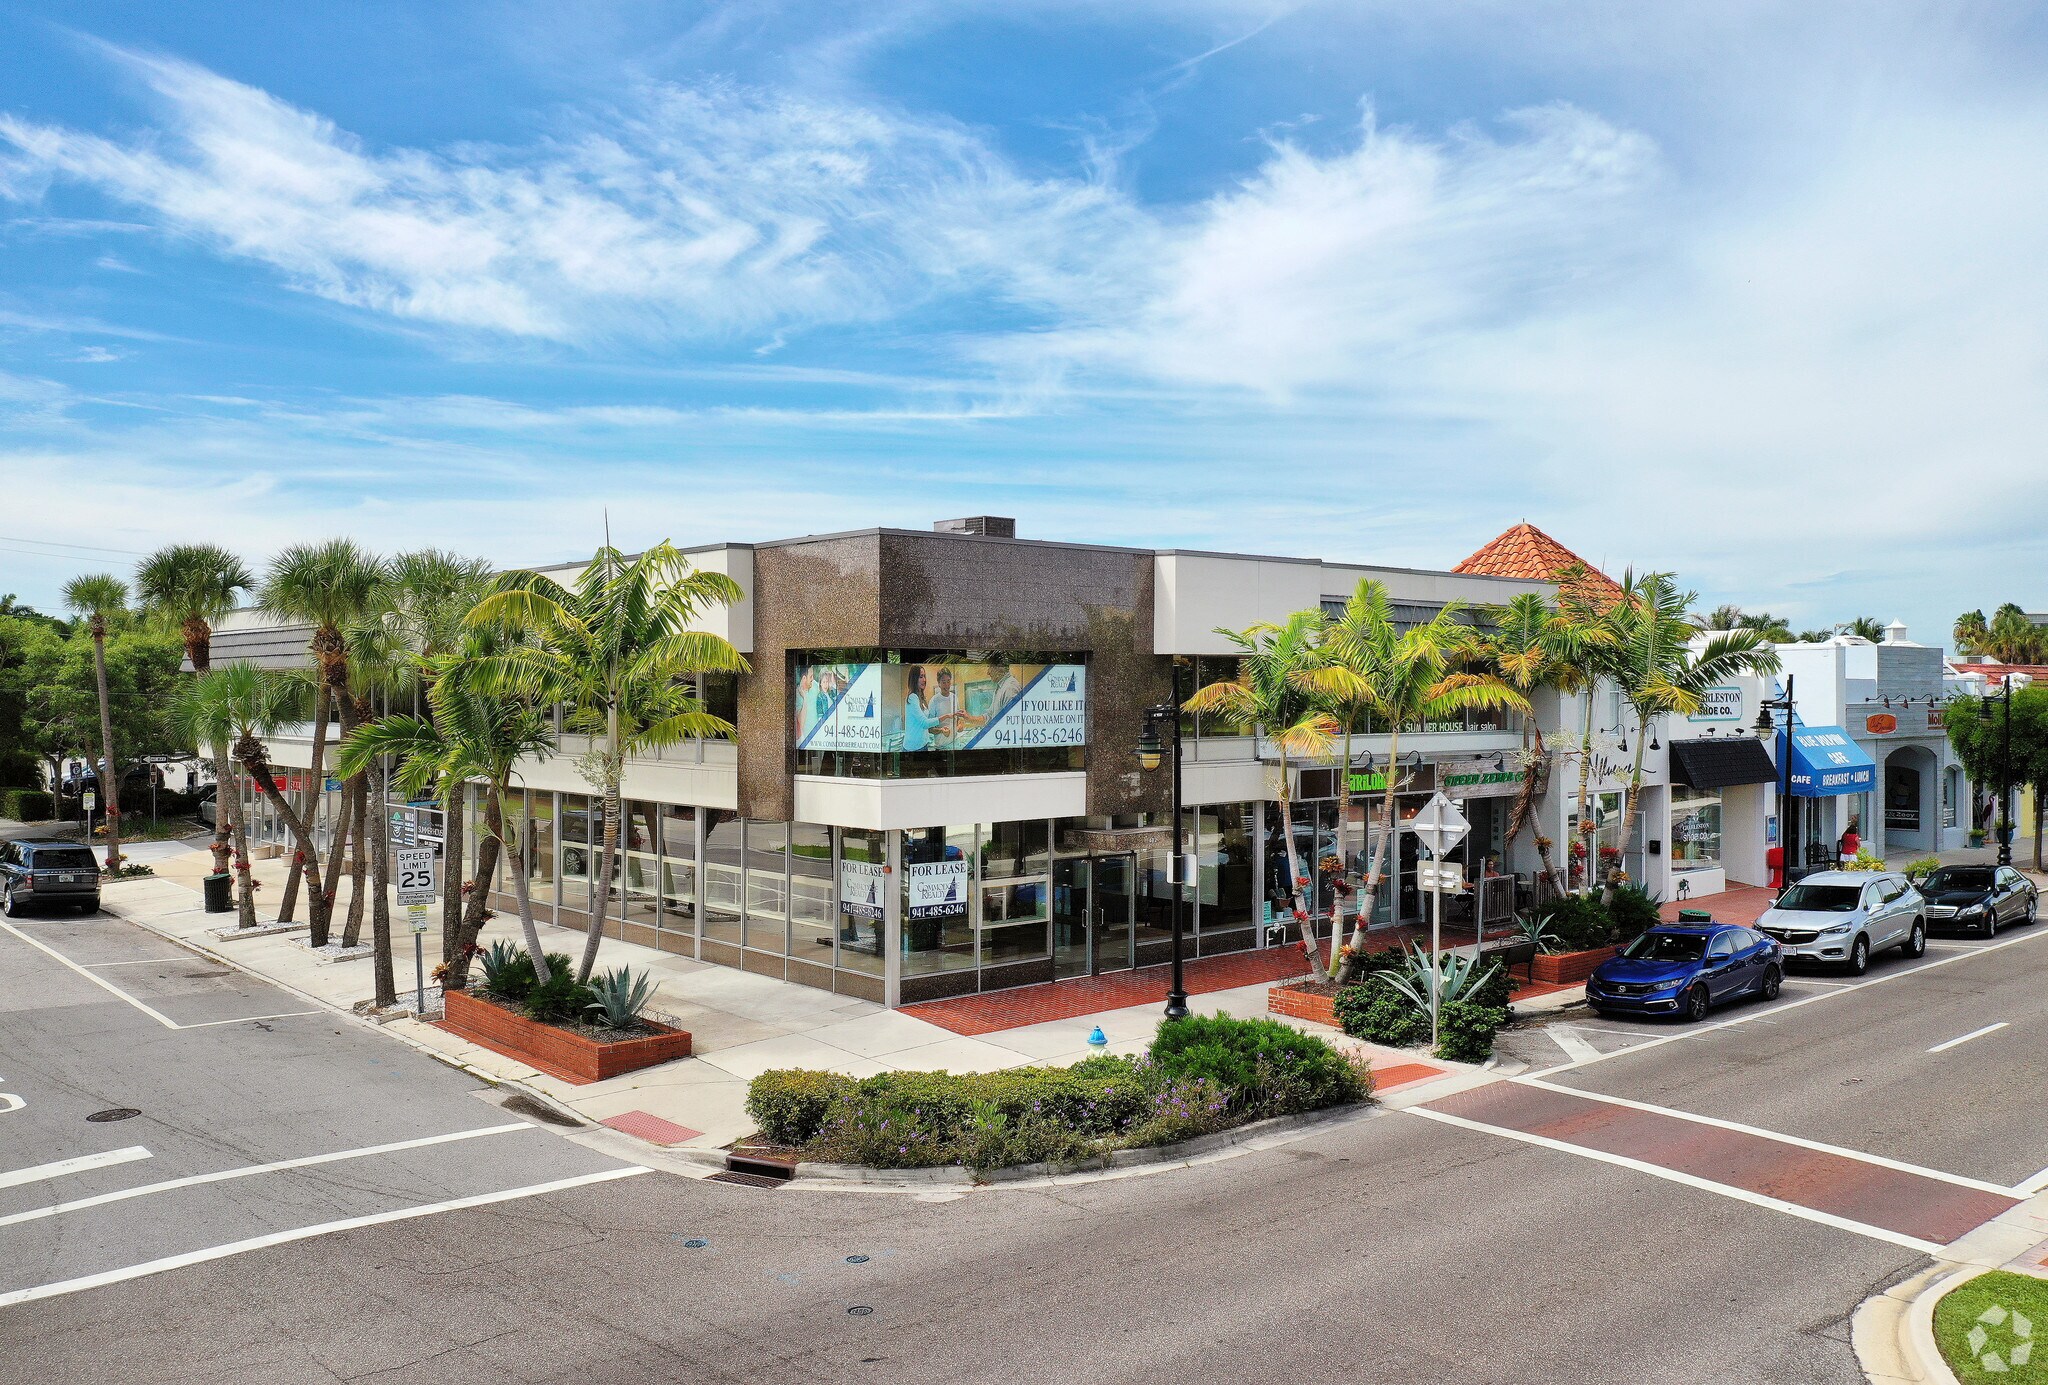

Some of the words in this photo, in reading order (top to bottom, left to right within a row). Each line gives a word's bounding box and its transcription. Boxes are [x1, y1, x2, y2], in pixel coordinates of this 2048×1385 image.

[1021, 700, 1030, 711] IF
[1031, 700, 1051, 711] YOU
[1052, 700, 1074, 711] LIKE
[1075, 700, 1085, 711] IT
[1719, 706, 1733, 715] CO.
[1006, 715, 1020, 725] PUT
[1021, 715, 1042, 725] YOUR
[1043, 714, 1064, 724] NAME
[1065, 714, 1076, 724] ON
[1077, 714, 1084, 724] IT
[824, 725, 880, 739] 94-485-6246
[1440, 722, 1464, 732] HOUSE
[1480, 722, 1497, 731] salon
[994, 727, 1083, 746] 941-485-6246
[1795, 734, 1820, 748] BLUE
[1827, 751, 1850, 765] CAFE
[1444, 774, 1480, 787] GREEN
[1791, 774, 1812, 785] CAFE
[1822, 772, 1850, 787] BREAKFAST
[1854, 770, 1870, 783] LUNCH
[399, 852, 431, 861] SPEED
[403, 861, 427, 870] LIMIT
[842, 861, 857, 874] FOR
[859, 864, 883, 878] LEASE
[911, 865, 932, 877] FOR
[935, 862, 966, 875] LEASE
[401, 871, 431, 888] 25
[917, 881, 960, 893] COMMODORE
[921, 889, 946, 900] REALTY
[912, 903, 964, 918] 941-485-6246
